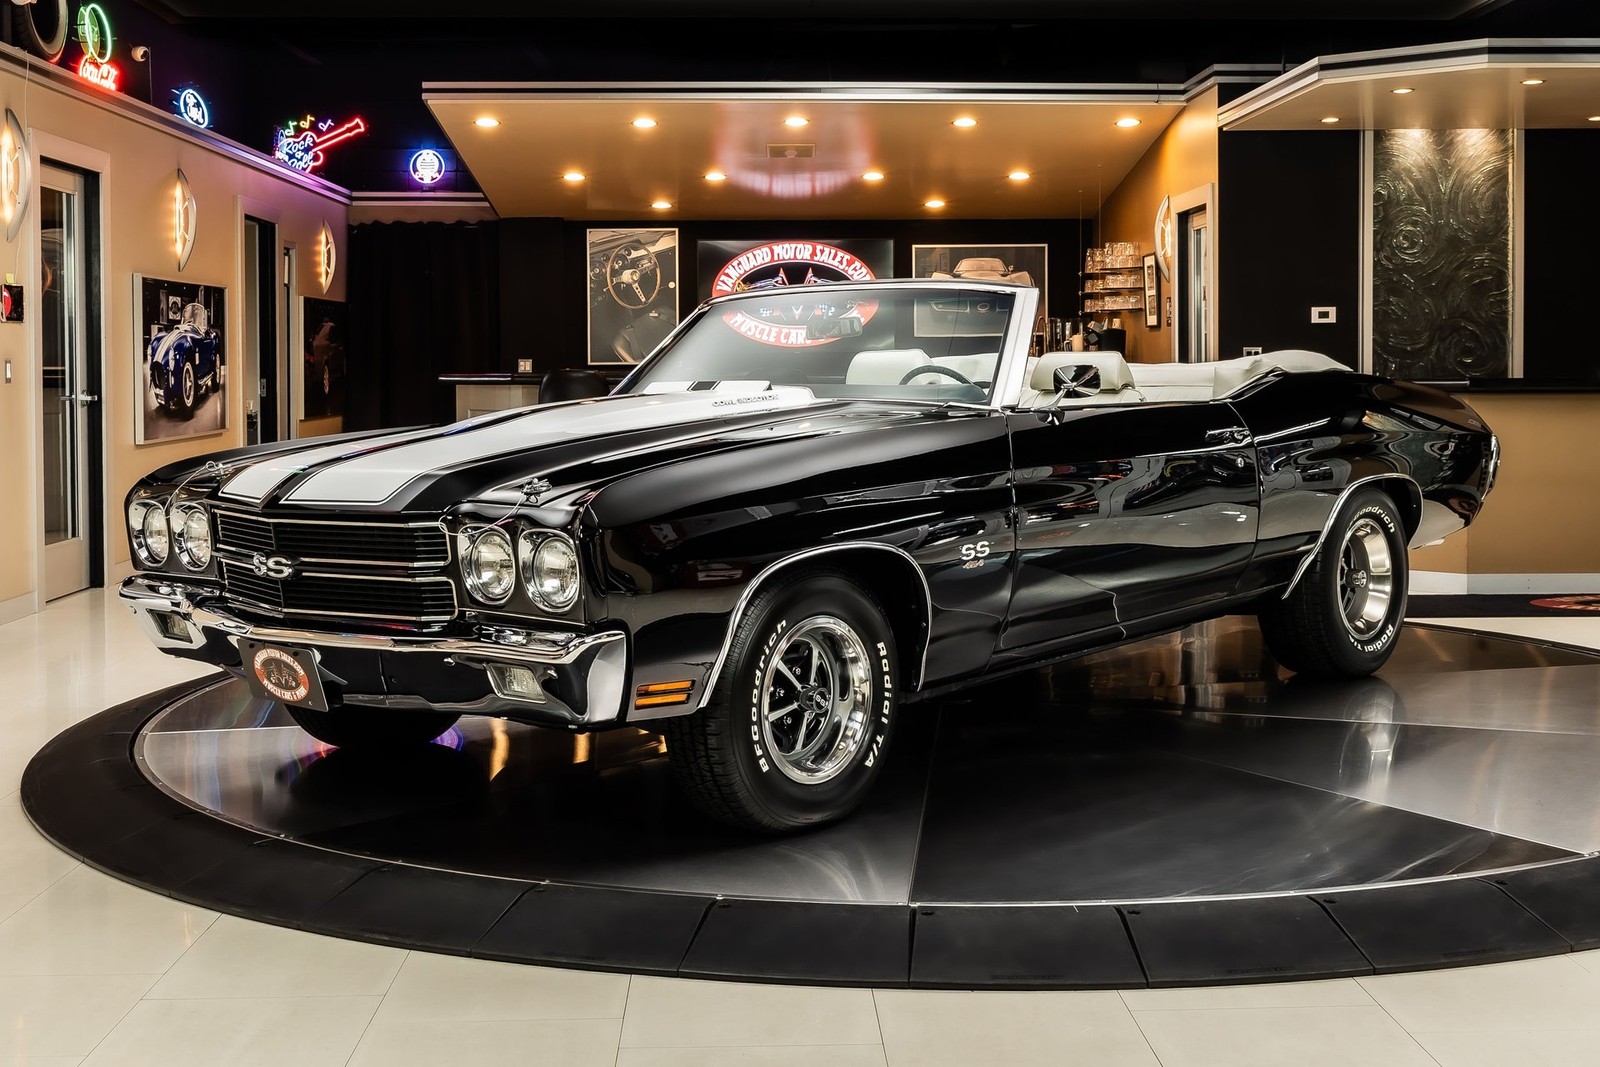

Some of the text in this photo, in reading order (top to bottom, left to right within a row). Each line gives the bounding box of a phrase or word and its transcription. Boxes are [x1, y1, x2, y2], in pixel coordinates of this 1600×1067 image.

[285, 134, 314, 154] Rock
[716, 247, 771, 293] VANGUARD
[772, 243, 815, 261] MOTOR
[730, 312, 775, 342] MUSCLE
[961, 541, 990, 560] SS
[253, 552, 292, 578] SS
[1364, 624, 1393, 652] Radial
[864, 641, 892, 768] Radial T/A
